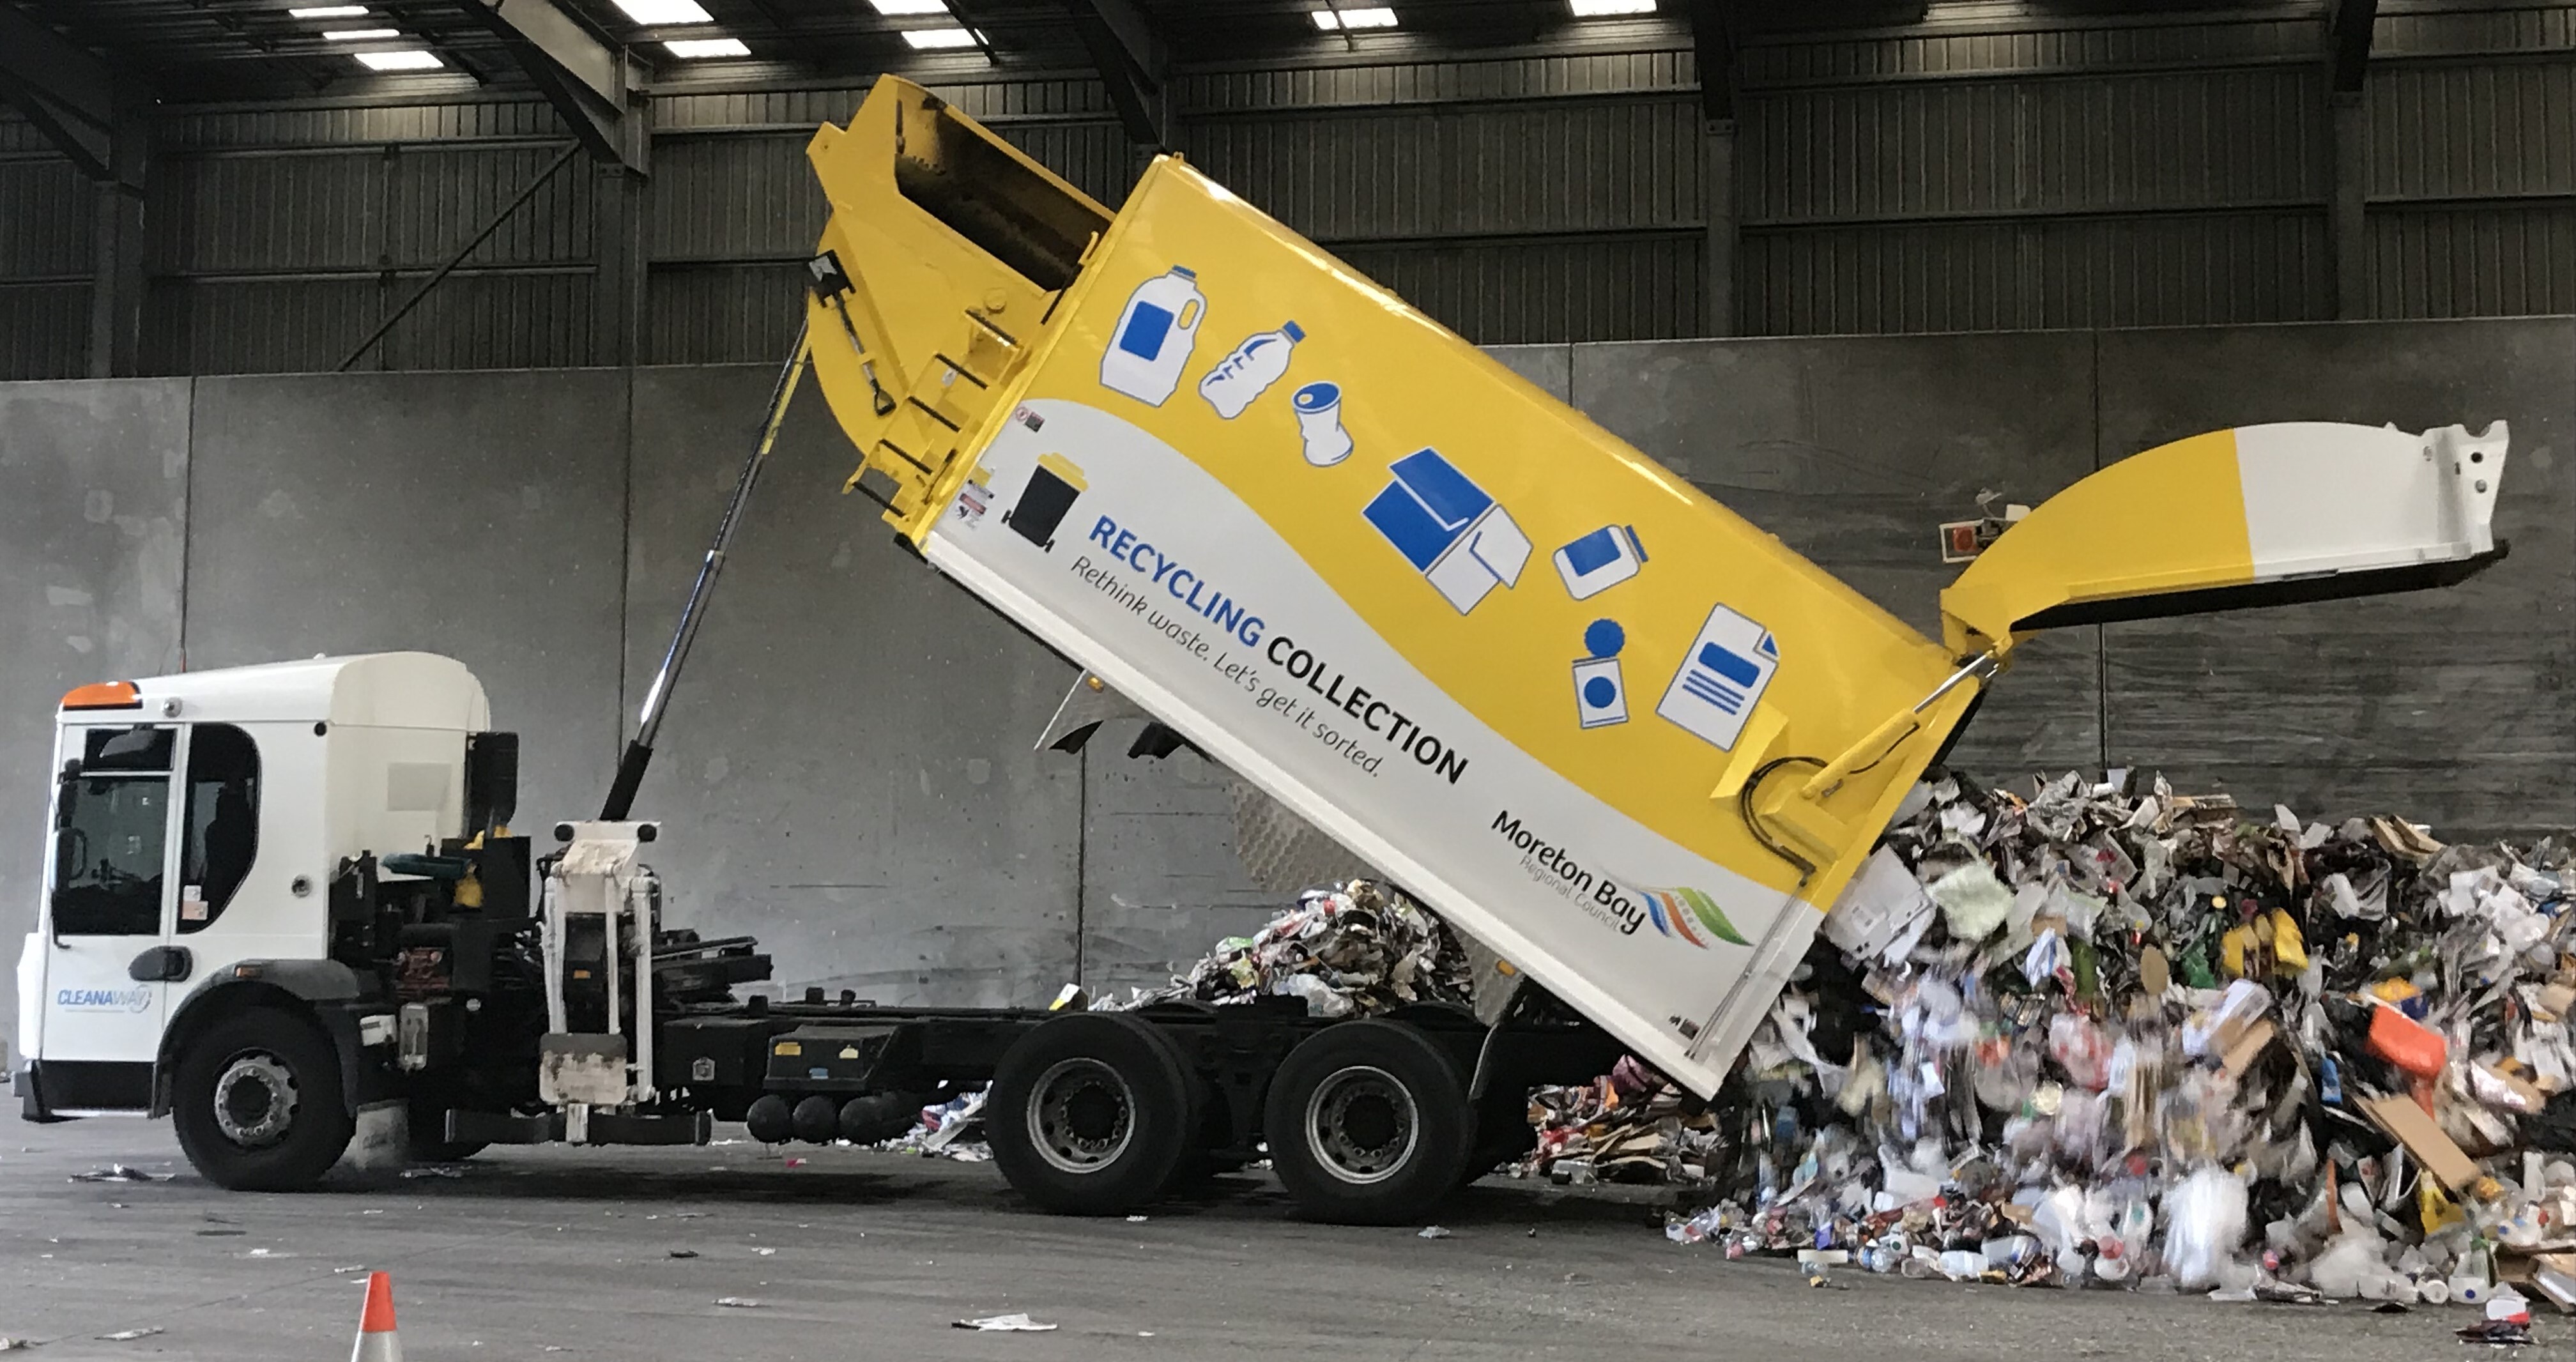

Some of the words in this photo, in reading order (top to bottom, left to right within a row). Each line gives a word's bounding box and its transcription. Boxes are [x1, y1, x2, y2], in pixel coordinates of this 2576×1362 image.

[1071, 555, 1149, 616] Rethink
[1148, 608, 1209, 662] waste.
[1213, 652, 1260, 692] Let's
[1256, 686, 1298, 717] get
[1294, 707, 1315, 730] it
[1312, 723, 1384, 777] sorted.
[1089, 515, 1266, 647] RECYCLING
[1267, 635, 1469, 784] COLLECTION
[1491, 810, 1593, 892] Moreton
[1593, 880, 1646, 936] Bay
[1519, 854, 1572, 899] Regional
[1574, 892, 1621, 932] Council
[57, 990, 148, 1006] CLEANAWAY
